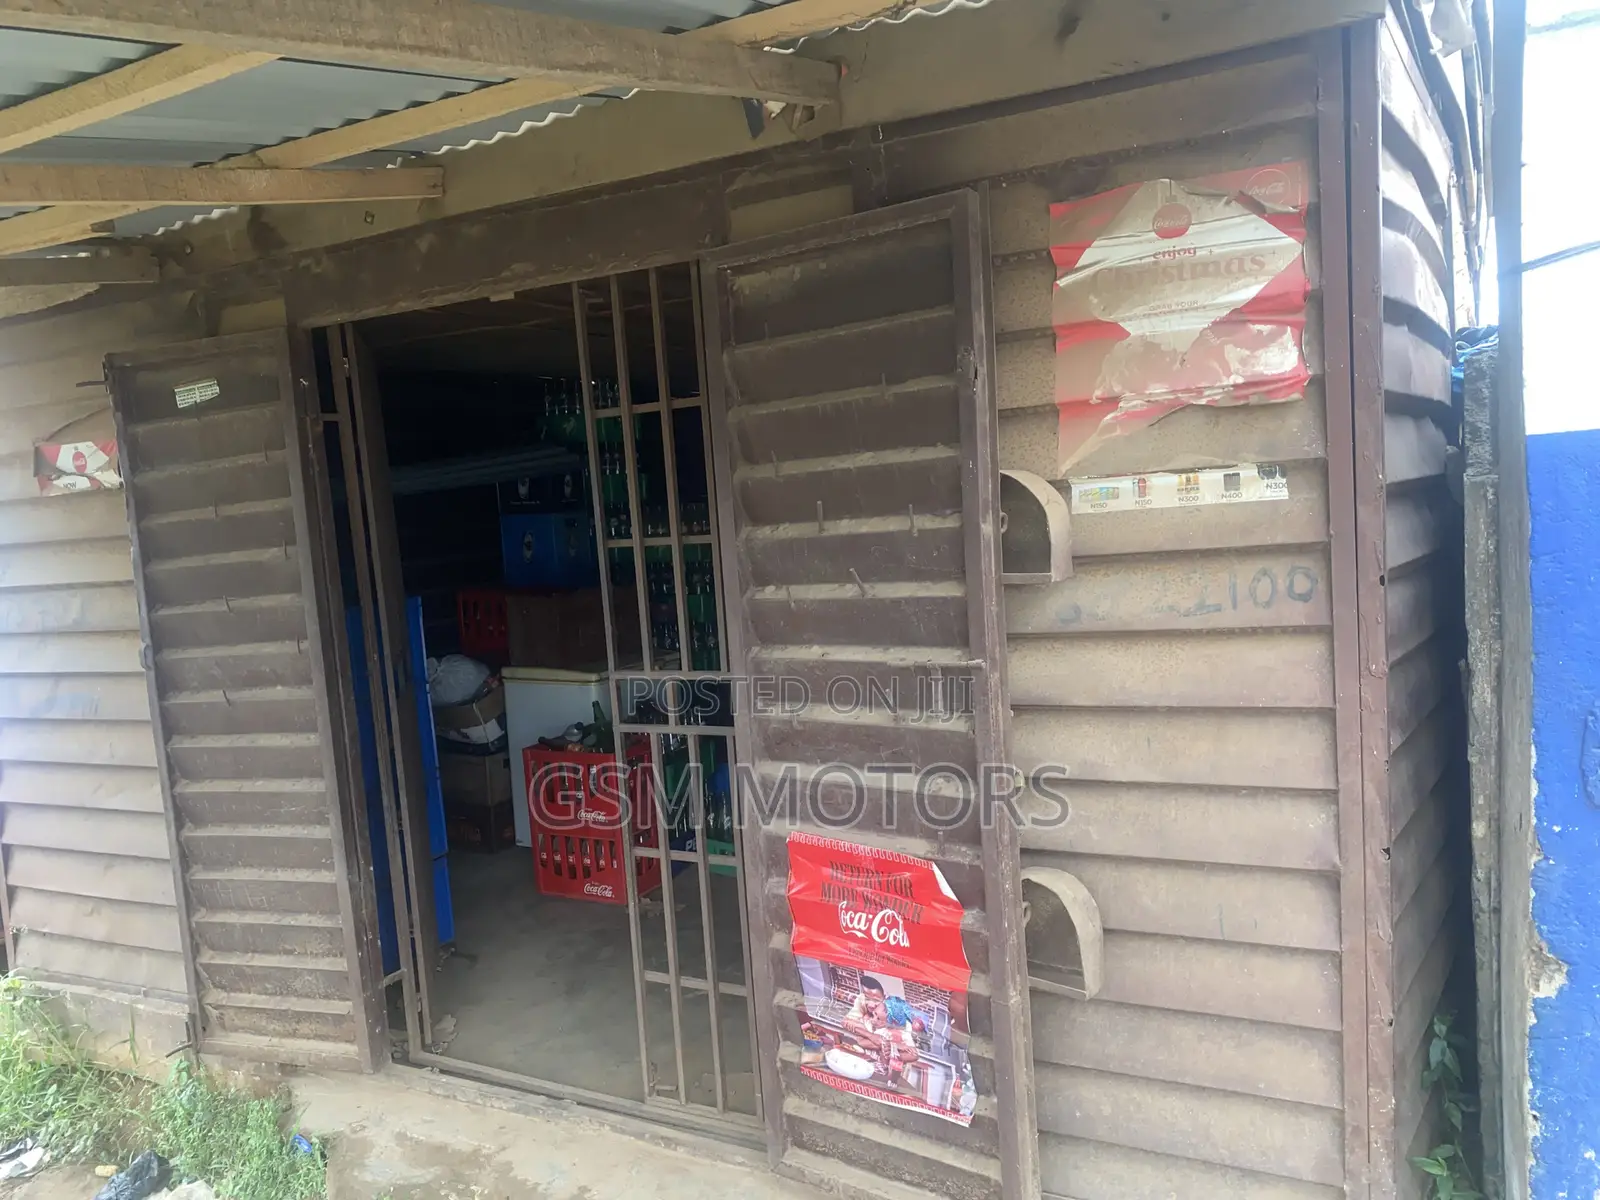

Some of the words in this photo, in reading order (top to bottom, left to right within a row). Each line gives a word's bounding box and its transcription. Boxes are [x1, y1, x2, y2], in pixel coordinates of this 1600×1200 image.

[1152, 244, 1197, 261] enjoy
[583, 882, 616, 898] Coca-Cola
[885, 871, 915, 900] FOR
